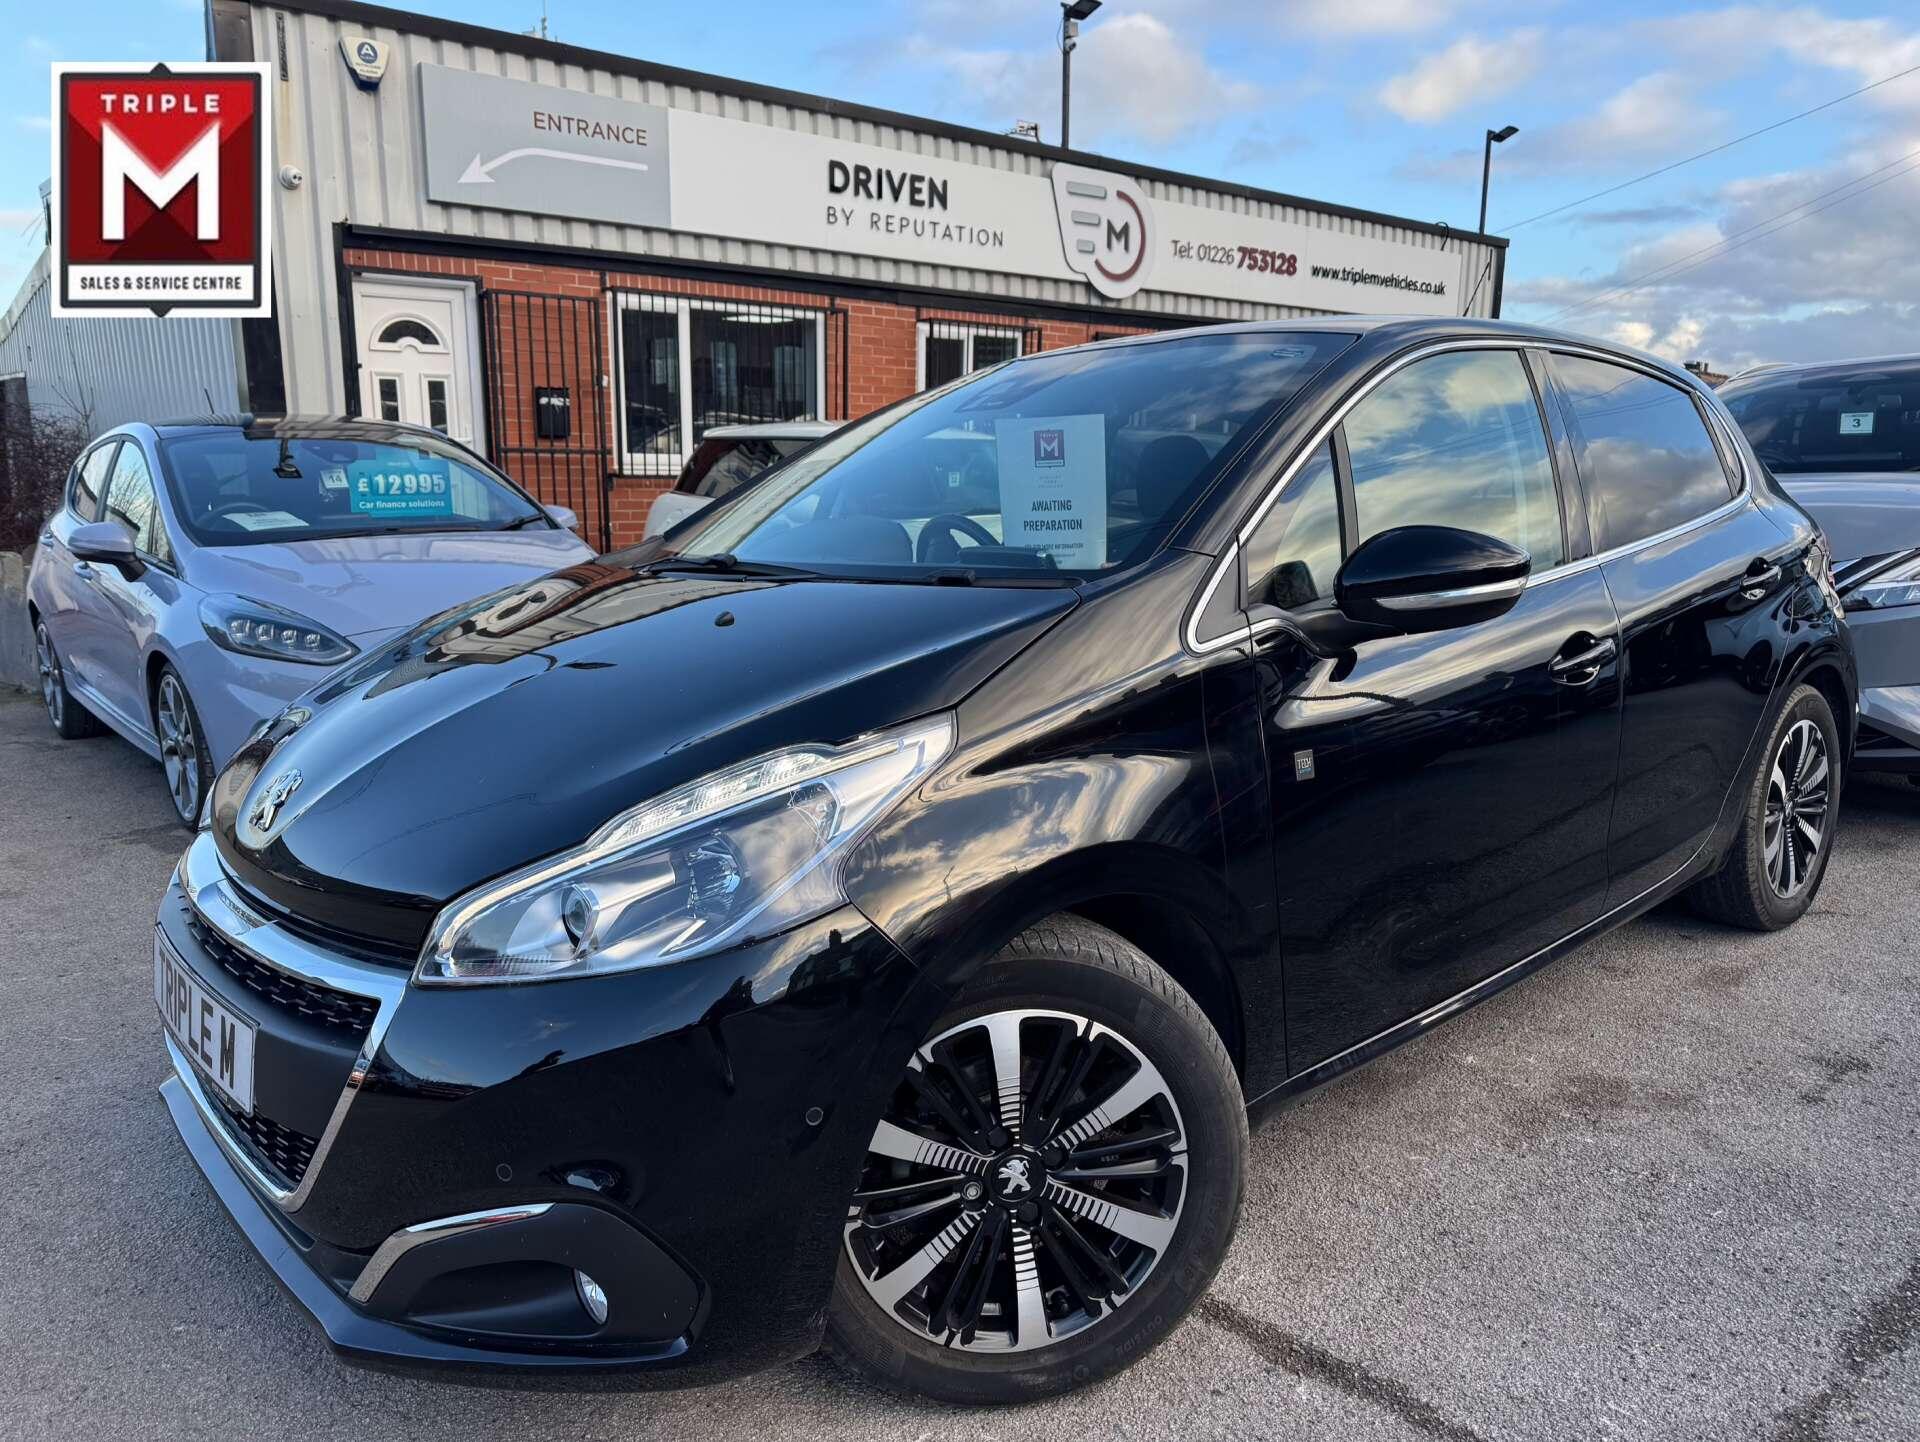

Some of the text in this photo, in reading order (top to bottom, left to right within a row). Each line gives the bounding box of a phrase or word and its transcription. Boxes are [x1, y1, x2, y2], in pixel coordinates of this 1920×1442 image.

[533, 111, 648, 147] ENTRANCE
[828, 159, 948, 211] DRIVEN
[826, 206, 1004, 248] BY REPUTATION
[1106, 218, 1130, 253] M
[1197, 244, 1235, 265] 01226
[1237, 246, 1298, 276] 753128
[1311, 263, 1446, 296] www.triplemvehicles.co.uk
[1852, 418, 1861, 428] 3
[1040, 437, 1059, 458] M
[359, 499, 445, 509] Car finance solutions
[1031, 499, 1072, 513] AWAITING
[1023, 518, 1083, 532] PREPARATION
[159, 947, 214, 1070] TRIPLE
[219, 1014, 236, 1091] M
